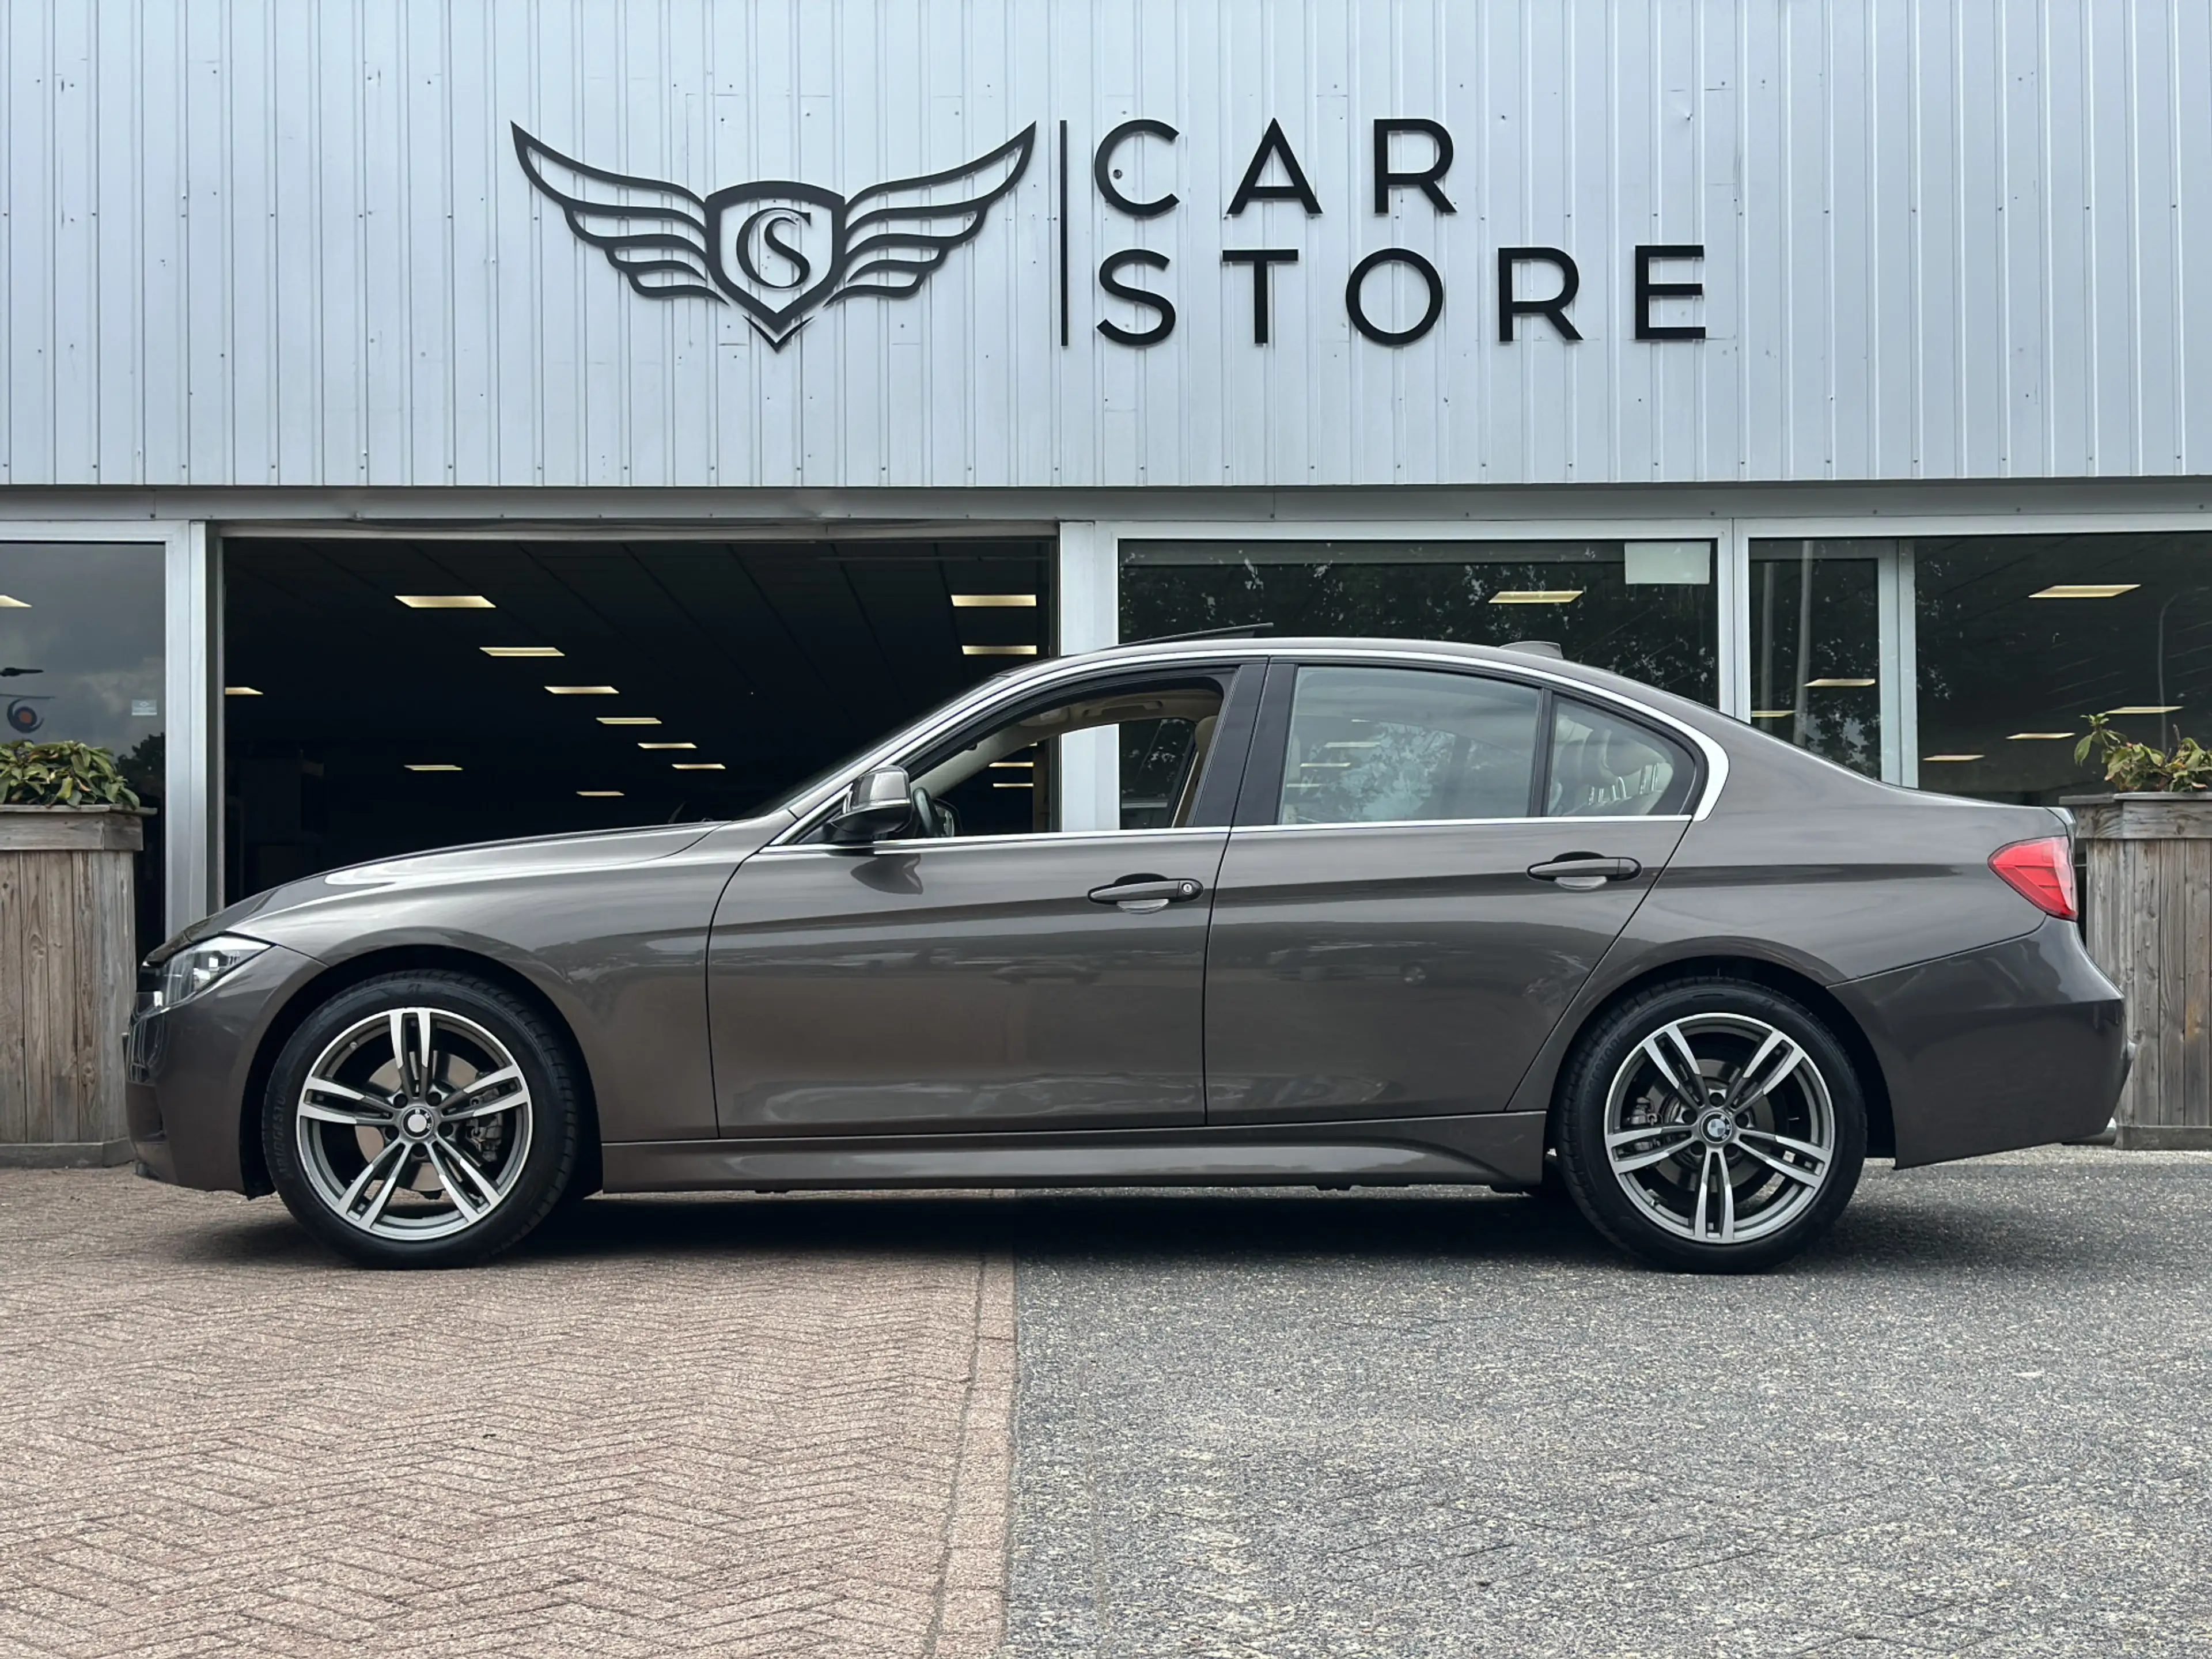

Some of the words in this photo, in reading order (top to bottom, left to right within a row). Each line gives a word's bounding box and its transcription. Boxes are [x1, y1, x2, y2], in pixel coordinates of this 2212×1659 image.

[1095, 118, 1456, 219] CAR
[736, 207, 812, 289] CS
[1096, 245, 1706, 347] STORE
